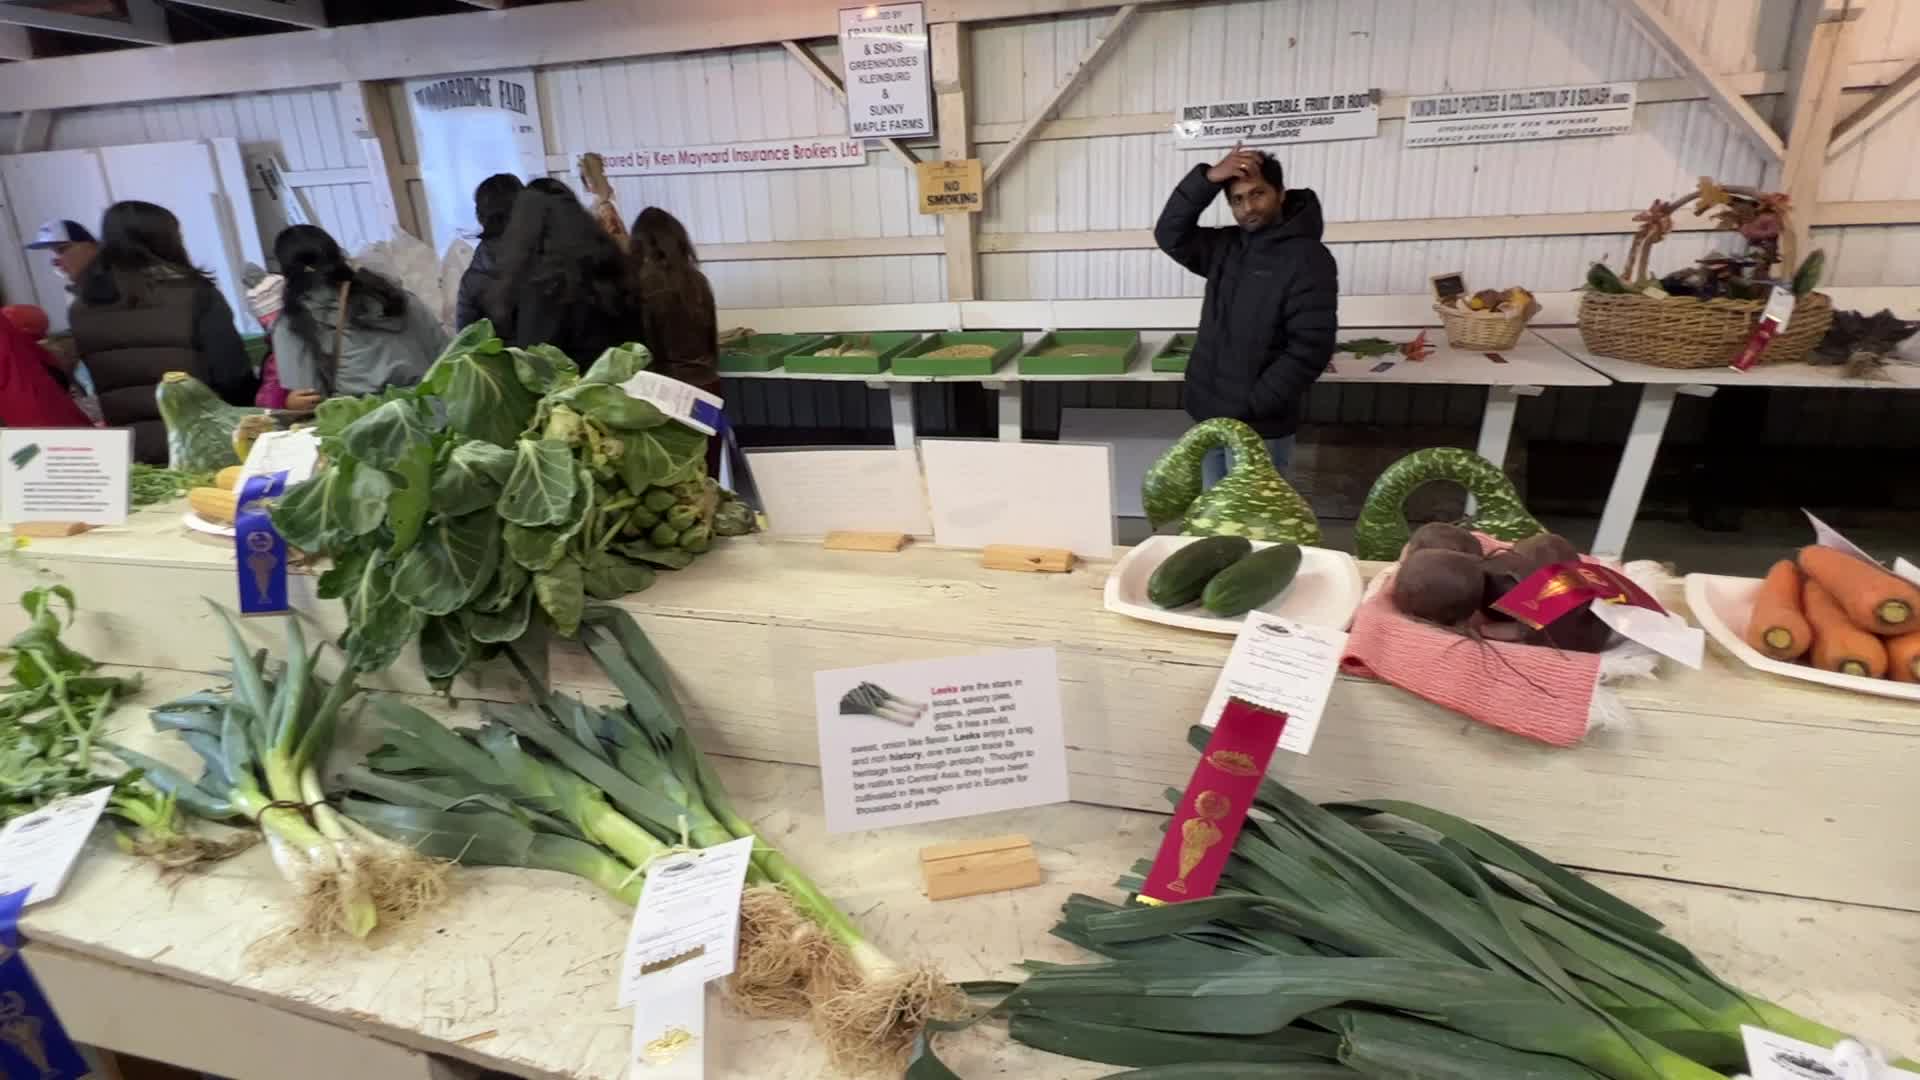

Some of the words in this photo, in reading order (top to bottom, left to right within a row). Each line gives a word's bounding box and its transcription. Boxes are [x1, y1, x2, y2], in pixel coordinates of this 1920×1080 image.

[864, 44, 872, 56] &
[873, 41, 904, 55] SONS
[849, 56, 919, 71] GREENHOUSES
[858, 71, 912, 84] KLEINBURG
[498, 79, 528, 115] FAIR
[881, 88, 889, 100] &
[869, 104, 905, 116] SUNNY
[1183, 106, 1207, 121] MOST
[1209, 103, 1250, 118] UNUSUAL
[1305, 96, 1331, 111] FRUIT
[1332, 95, 1345, 110] OR
[854, 120, 888, 133] MAPLE
[889, 118, 924, 132] FARMS
[1203, 124, 1256, 136] Memory
[1260, 120, 1275, 132] of
[636, 151, 650, 169] by
[653, 150, 676, 166] Ken
[678, 147, 729, 167] Maynard
[732, 147, 790, 162] Insurance
[793, 142, 838, 160] Brokers
[944, 180, 961, 193] NO
[927, 192, 978, 206] SMOKING
[932, 685, 959, 695] Leeks
[961, 683, 975, 692] are
[977, 680, 990, 690] the
[992, 680, 1012, 689] stars
[953, 730, 981, 742] Leeks
[852, 756, 869, 766] and
